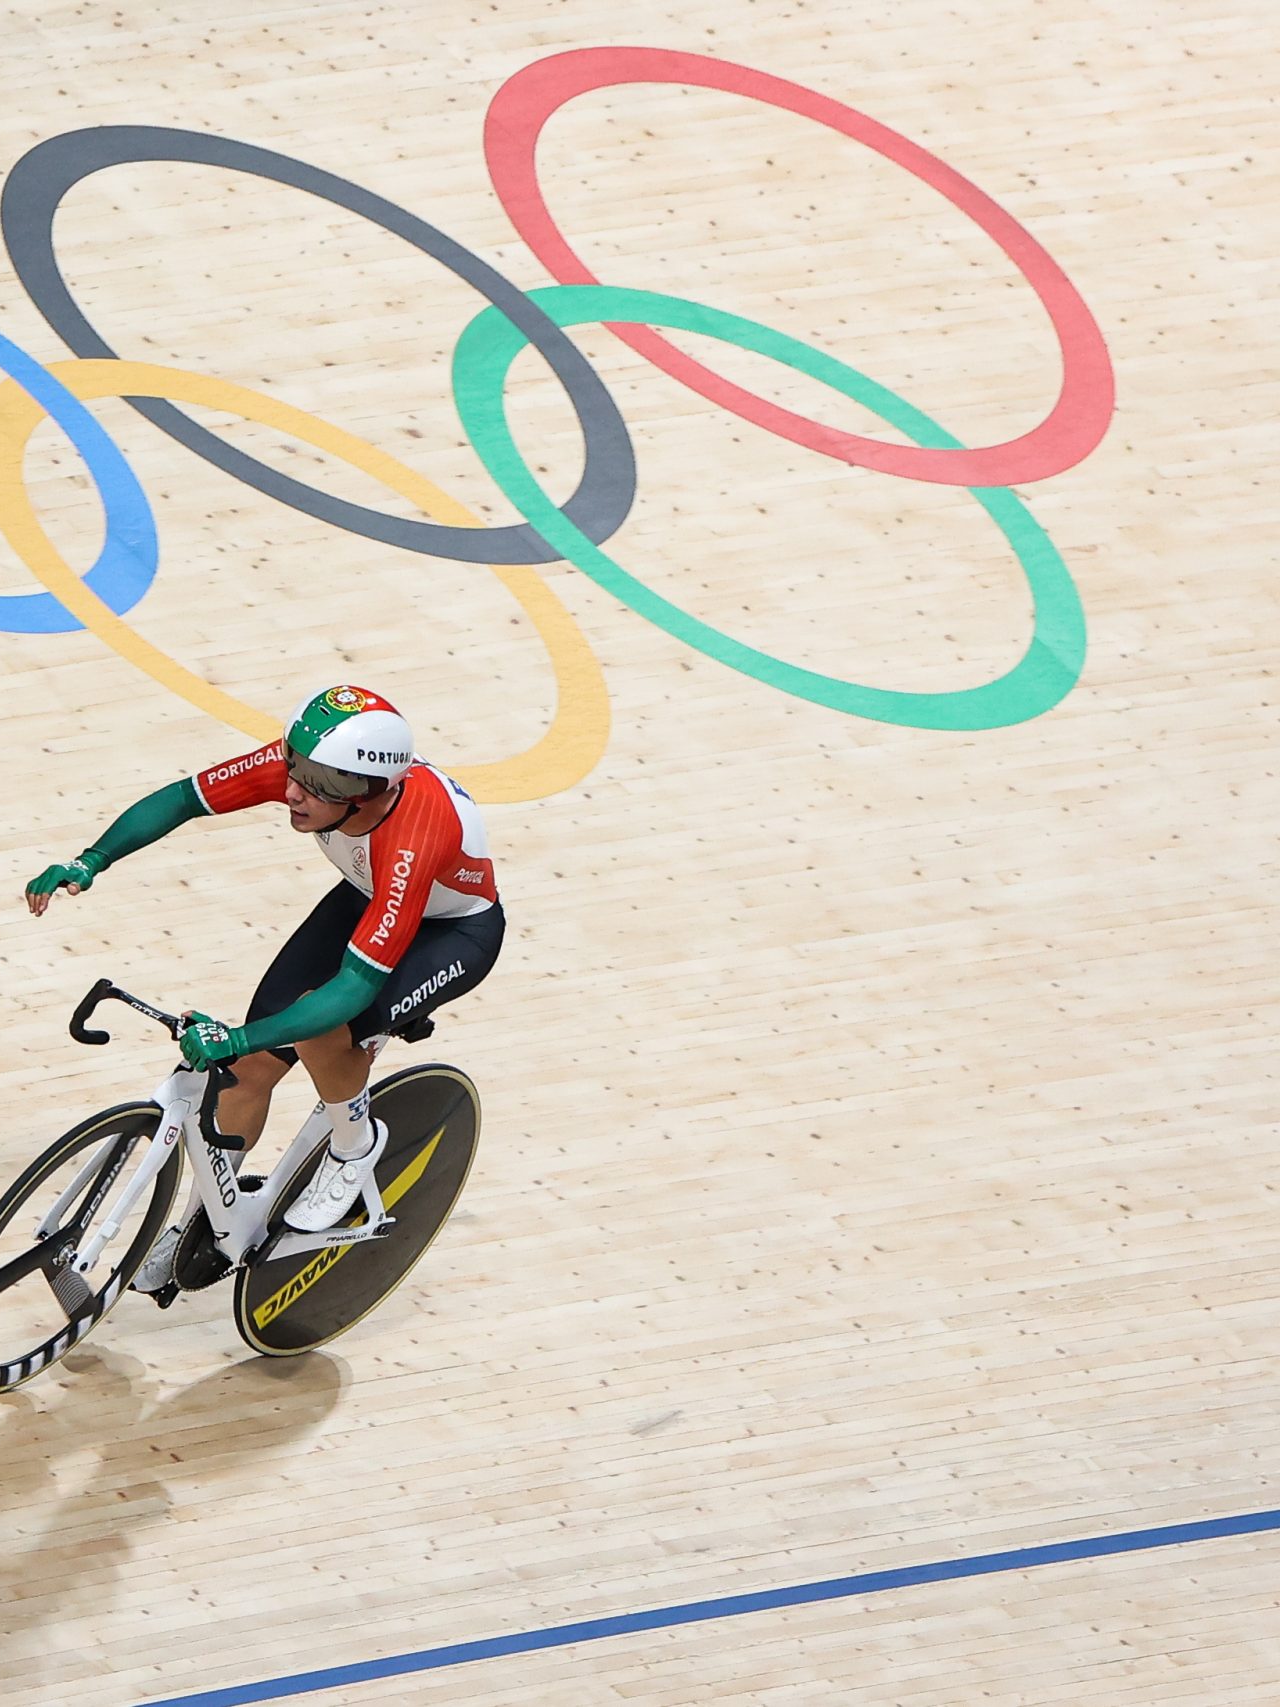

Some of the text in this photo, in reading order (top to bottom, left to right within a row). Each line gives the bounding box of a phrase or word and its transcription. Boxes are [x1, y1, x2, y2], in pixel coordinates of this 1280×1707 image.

[207, 745, 285, 785] PORTUGAL
[369, 849, 416, 947] PORTUGAL
[390, 960, 465, 1021] PORTUGAL
[263, 1245, 341, 1322] MAVIC
